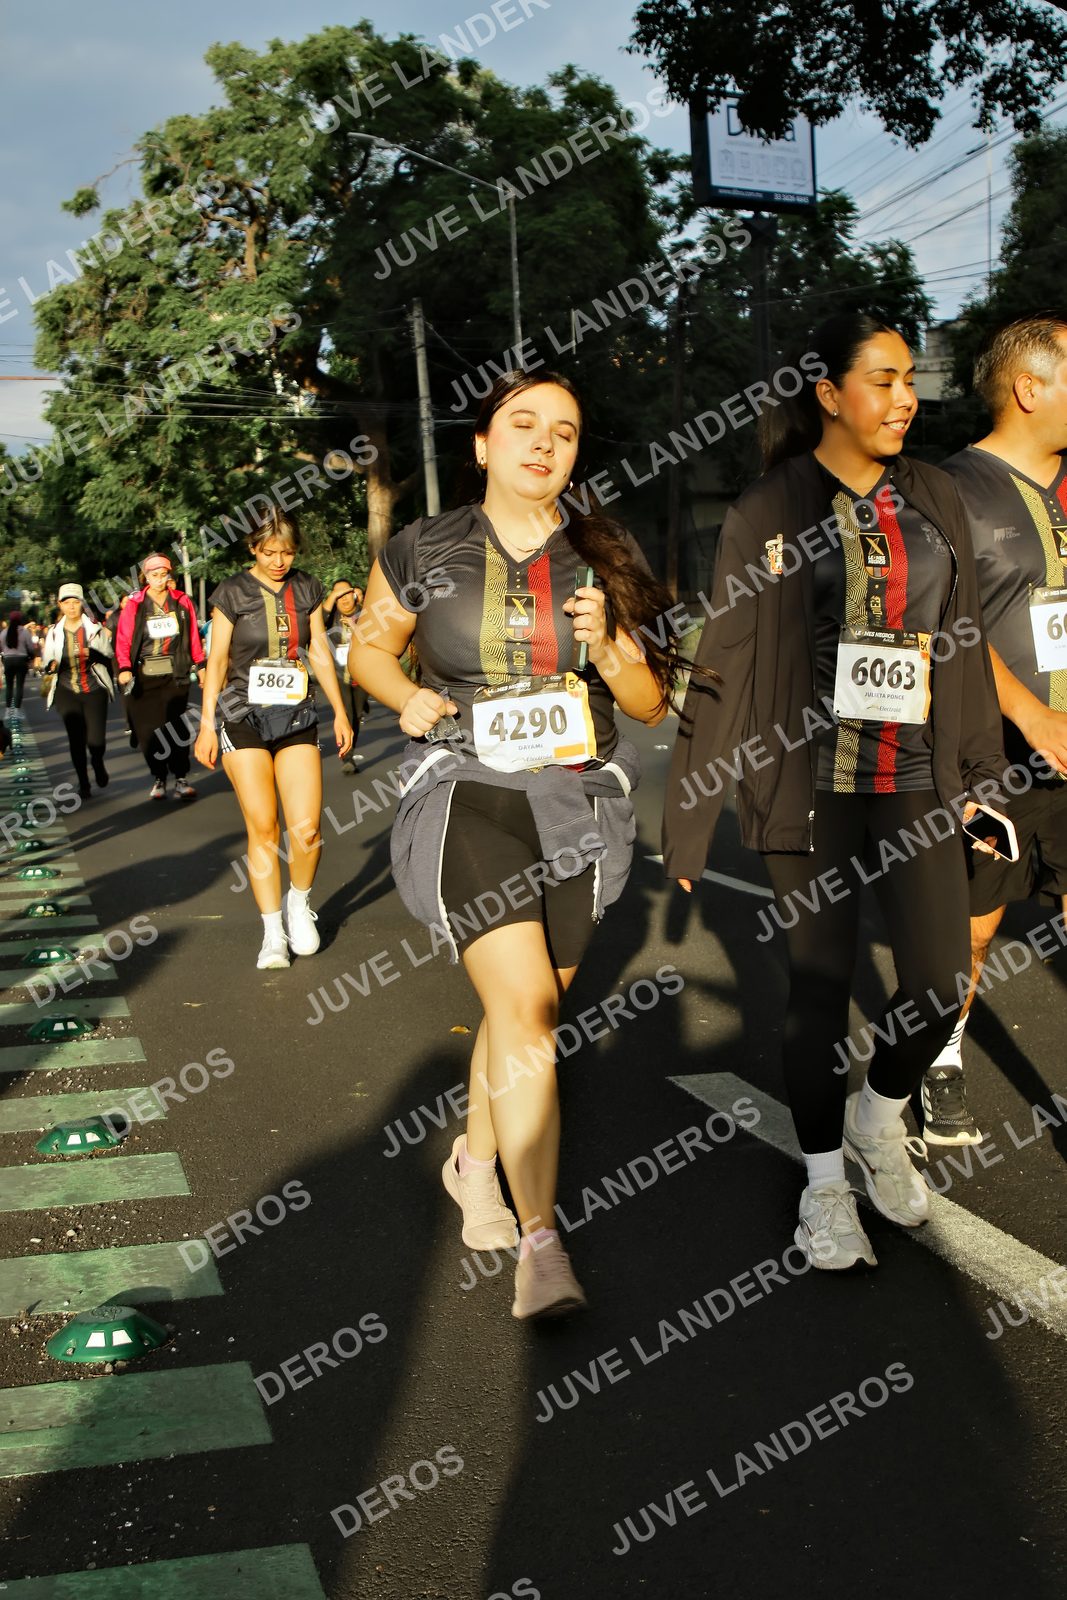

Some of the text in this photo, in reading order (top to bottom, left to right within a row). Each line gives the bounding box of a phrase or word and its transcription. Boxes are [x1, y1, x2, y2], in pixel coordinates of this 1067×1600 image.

[257, 673, 294, 688] 5862
[851, 656, 916, 691] 6063
[489, 704, 567, 742] 4290
